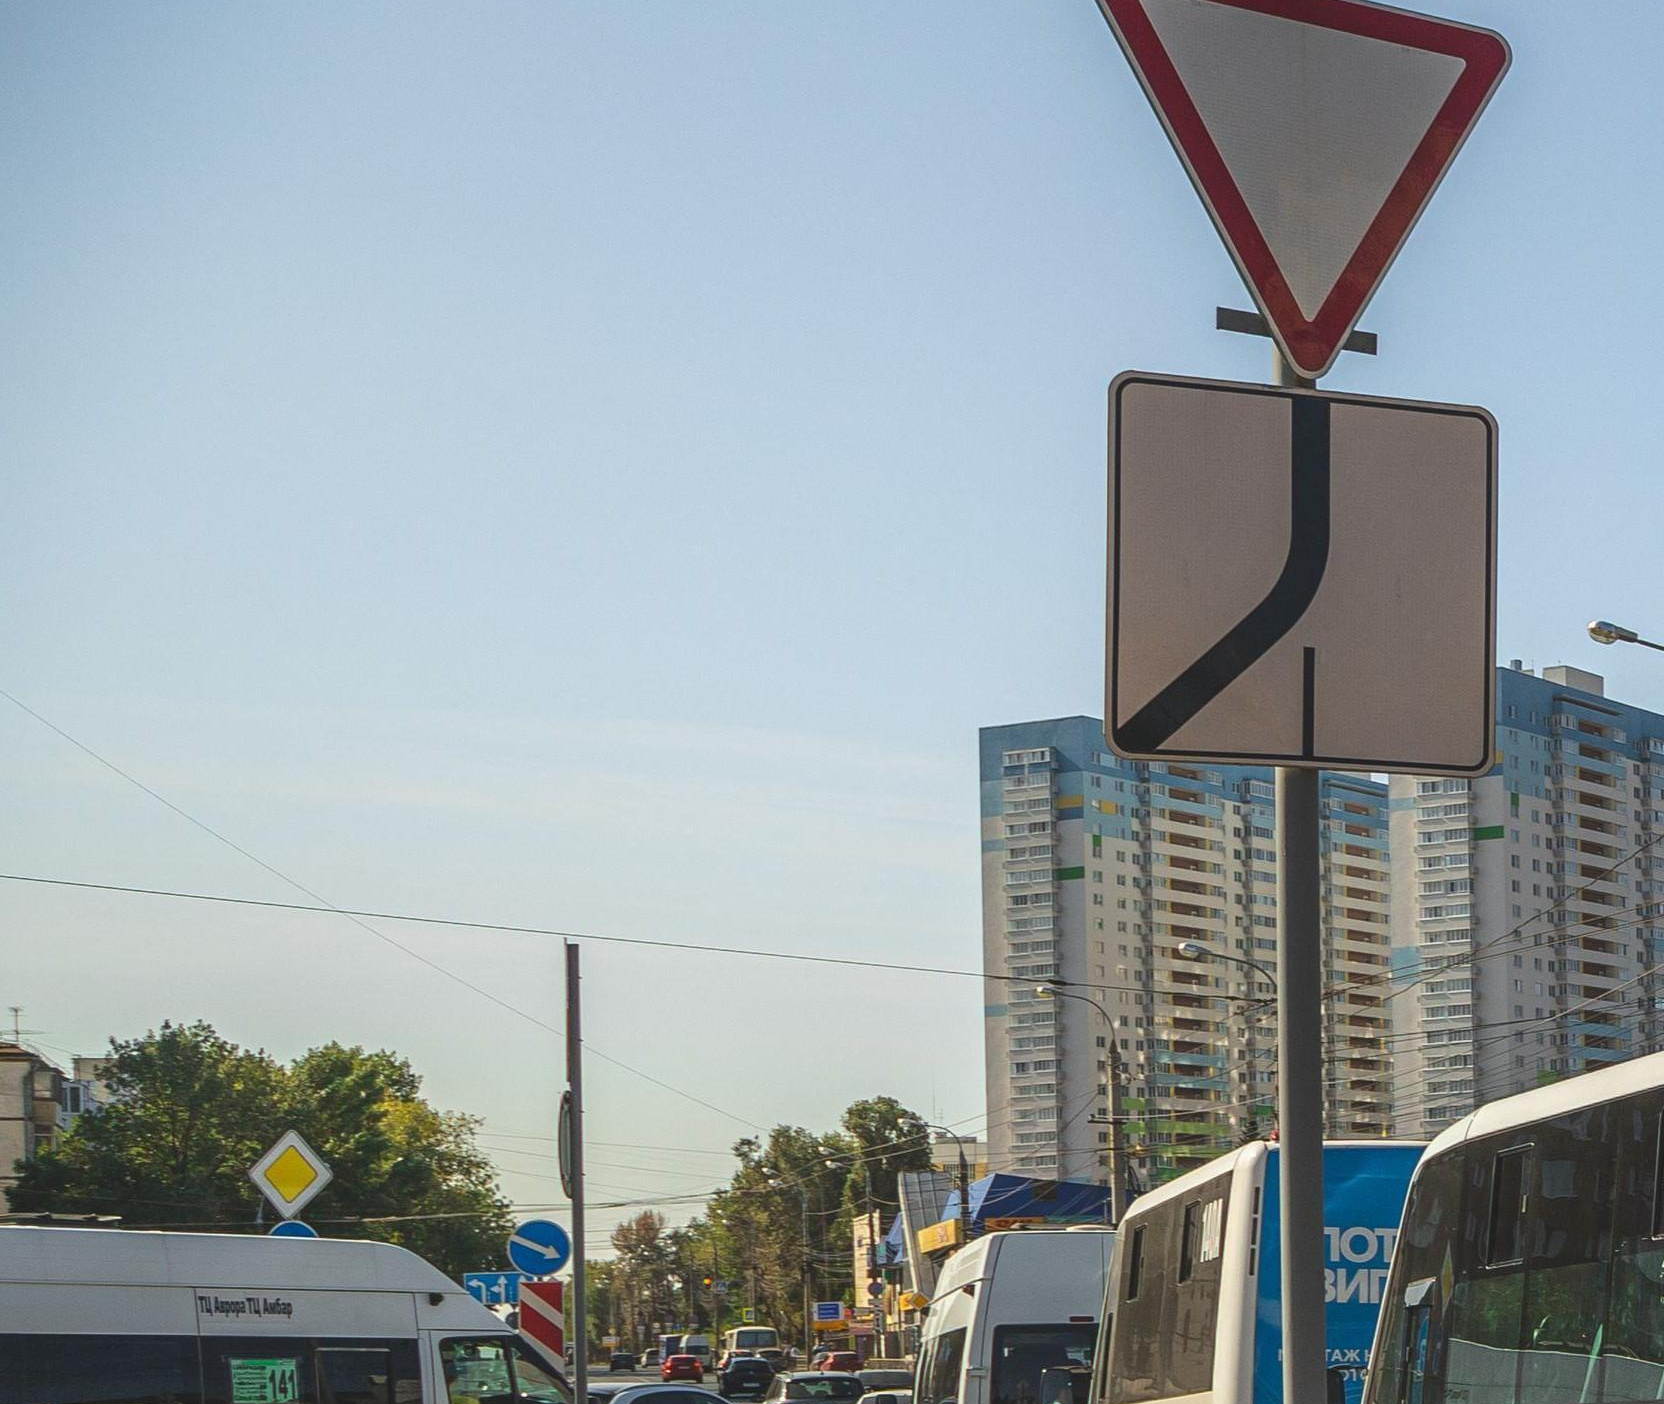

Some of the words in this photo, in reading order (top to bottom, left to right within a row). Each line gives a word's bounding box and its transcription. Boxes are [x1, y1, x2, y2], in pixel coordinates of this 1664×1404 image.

[198, 1296, 214, 1317] ТЦ
[214, 1297, 247, 1318] Аврора
[246, 1297, 263, 1318] ТЦ
[263, 1298, 294, 1319] Амбар
[268, 1369, 298, 1400] 141
